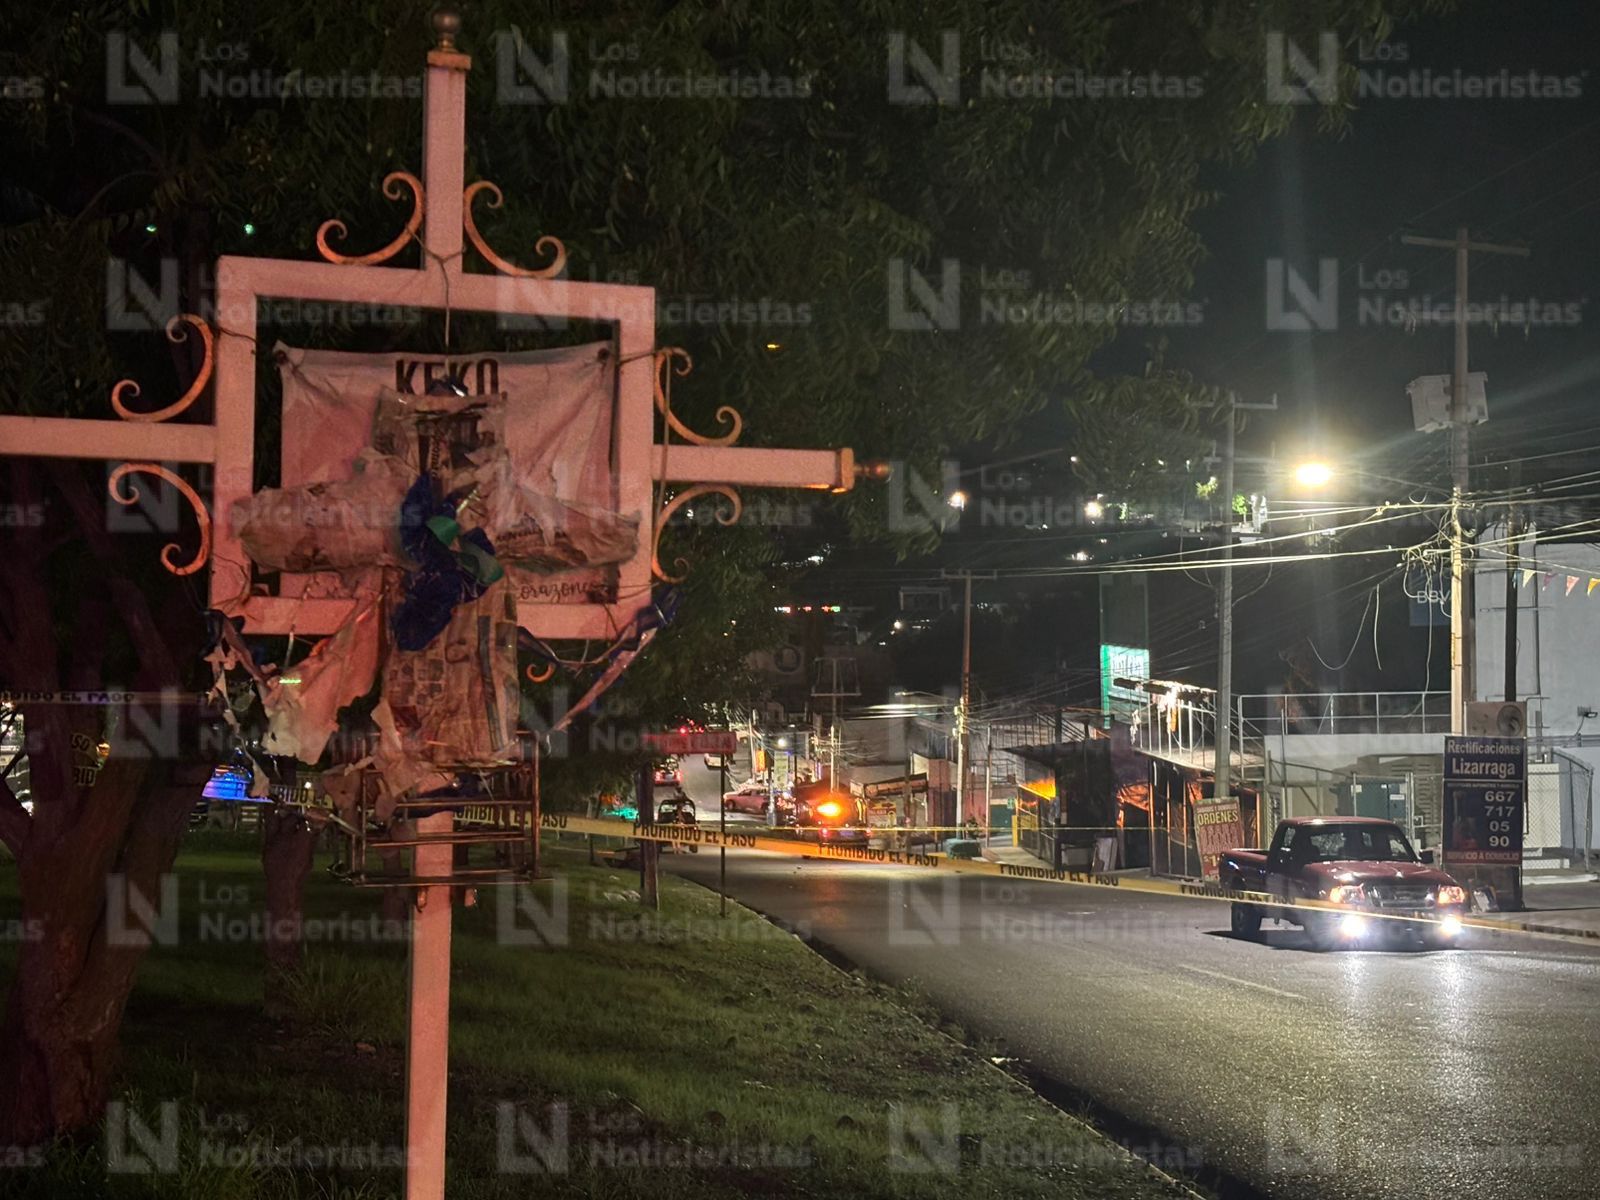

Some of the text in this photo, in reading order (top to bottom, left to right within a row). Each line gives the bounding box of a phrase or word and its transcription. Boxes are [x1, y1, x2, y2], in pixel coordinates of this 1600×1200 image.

[1417, 590, 1451, 604] BBV
[1451, 757, 1516, 779] Lizarraga
[1484, 790, 1516, 803] 667
[1197, 810, 1239, 826] ORDENES
[1484, 806, 1516, 818] 717
[1488, 820, 1510, 832] 05
[633, 823, 757, 848] PROHIBIDO EL PASO
[1488, 835, 1510, 847] 90
[888, 850, 903, 863] EL
[906, 853, 938, 867] PASO
[1069, 870, 1084, 883] EL
